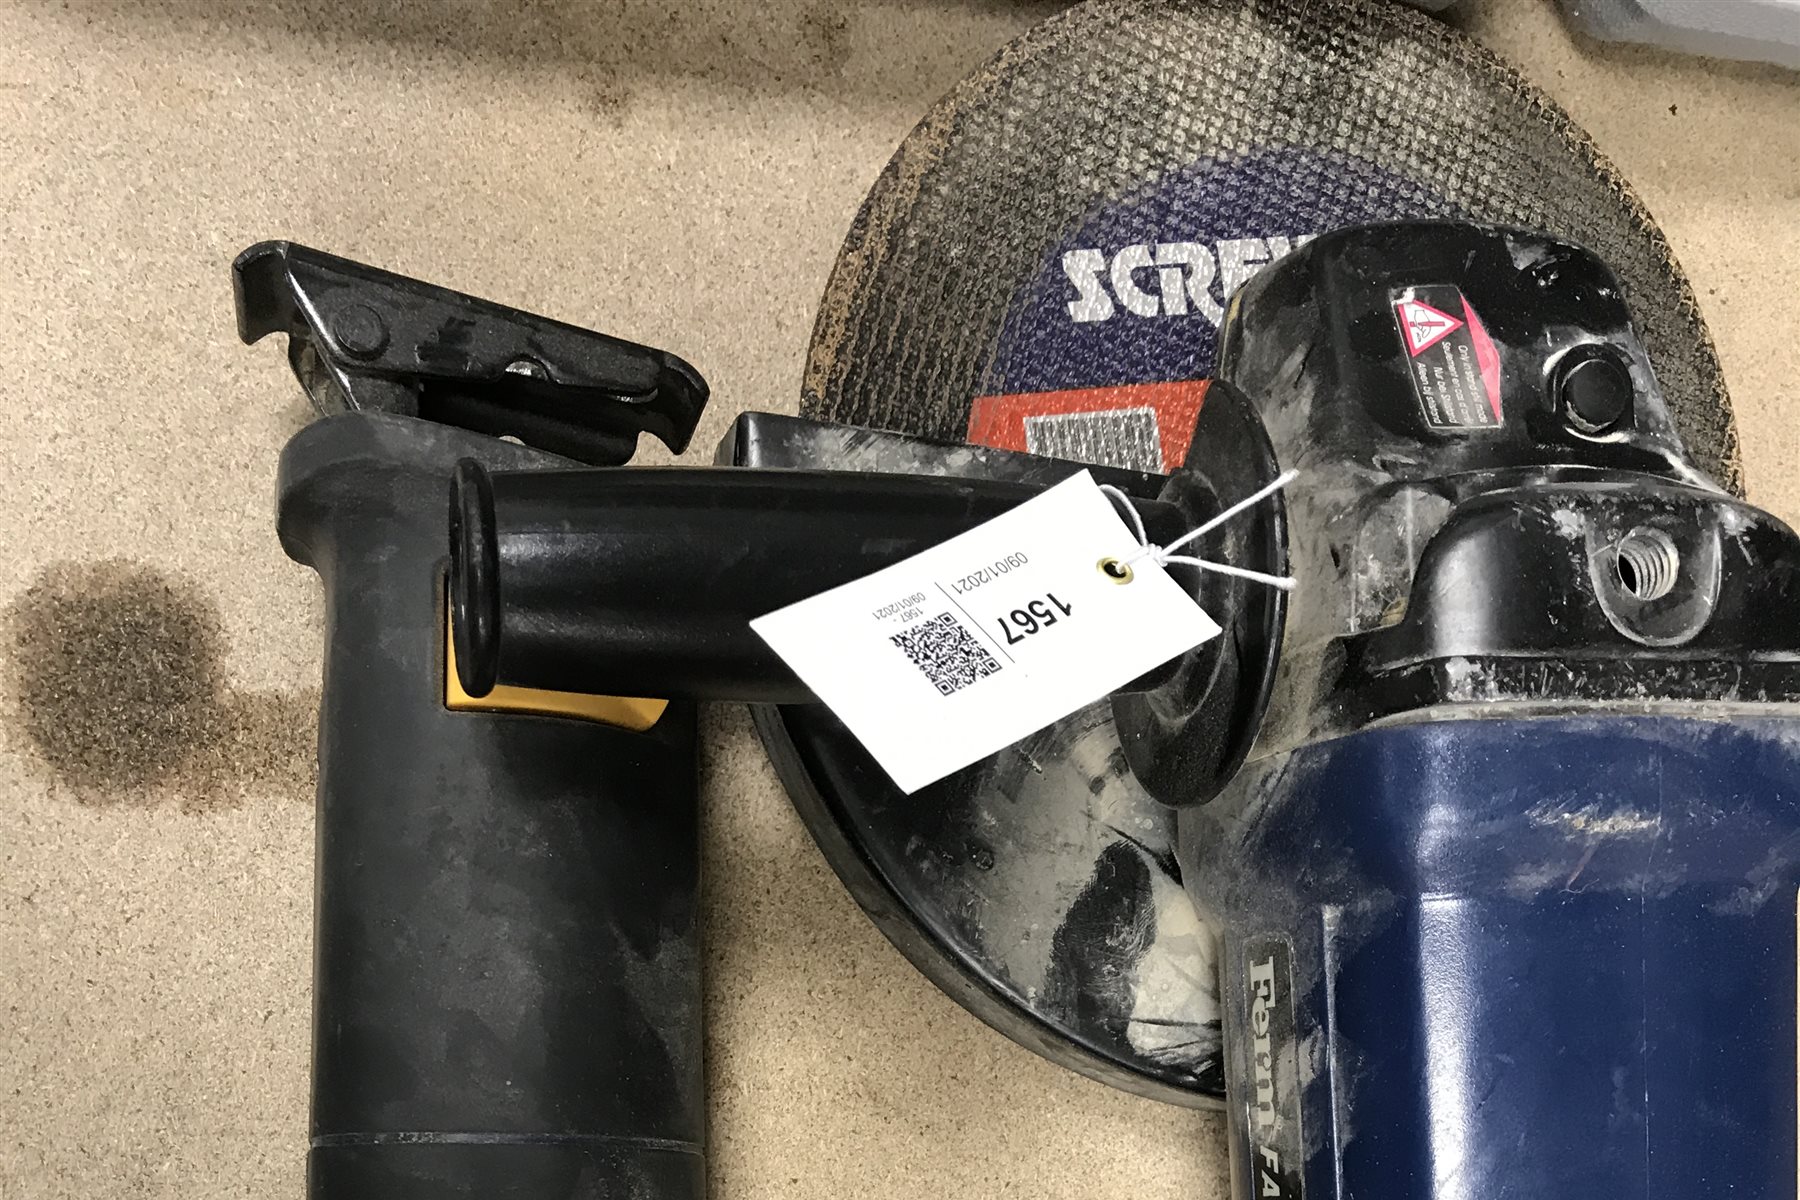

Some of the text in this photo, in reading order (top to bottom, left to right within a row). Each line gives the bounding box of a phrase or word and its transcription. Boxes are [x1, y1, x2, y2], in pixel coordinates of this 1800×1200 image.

[951, 551, 1028, 595] 09/01/2021
[872, 592, 926, 620] 09/01/2021
[997, 593, 1072, 645] 1567
[1249, 955, 1275, 1130] Ferm
